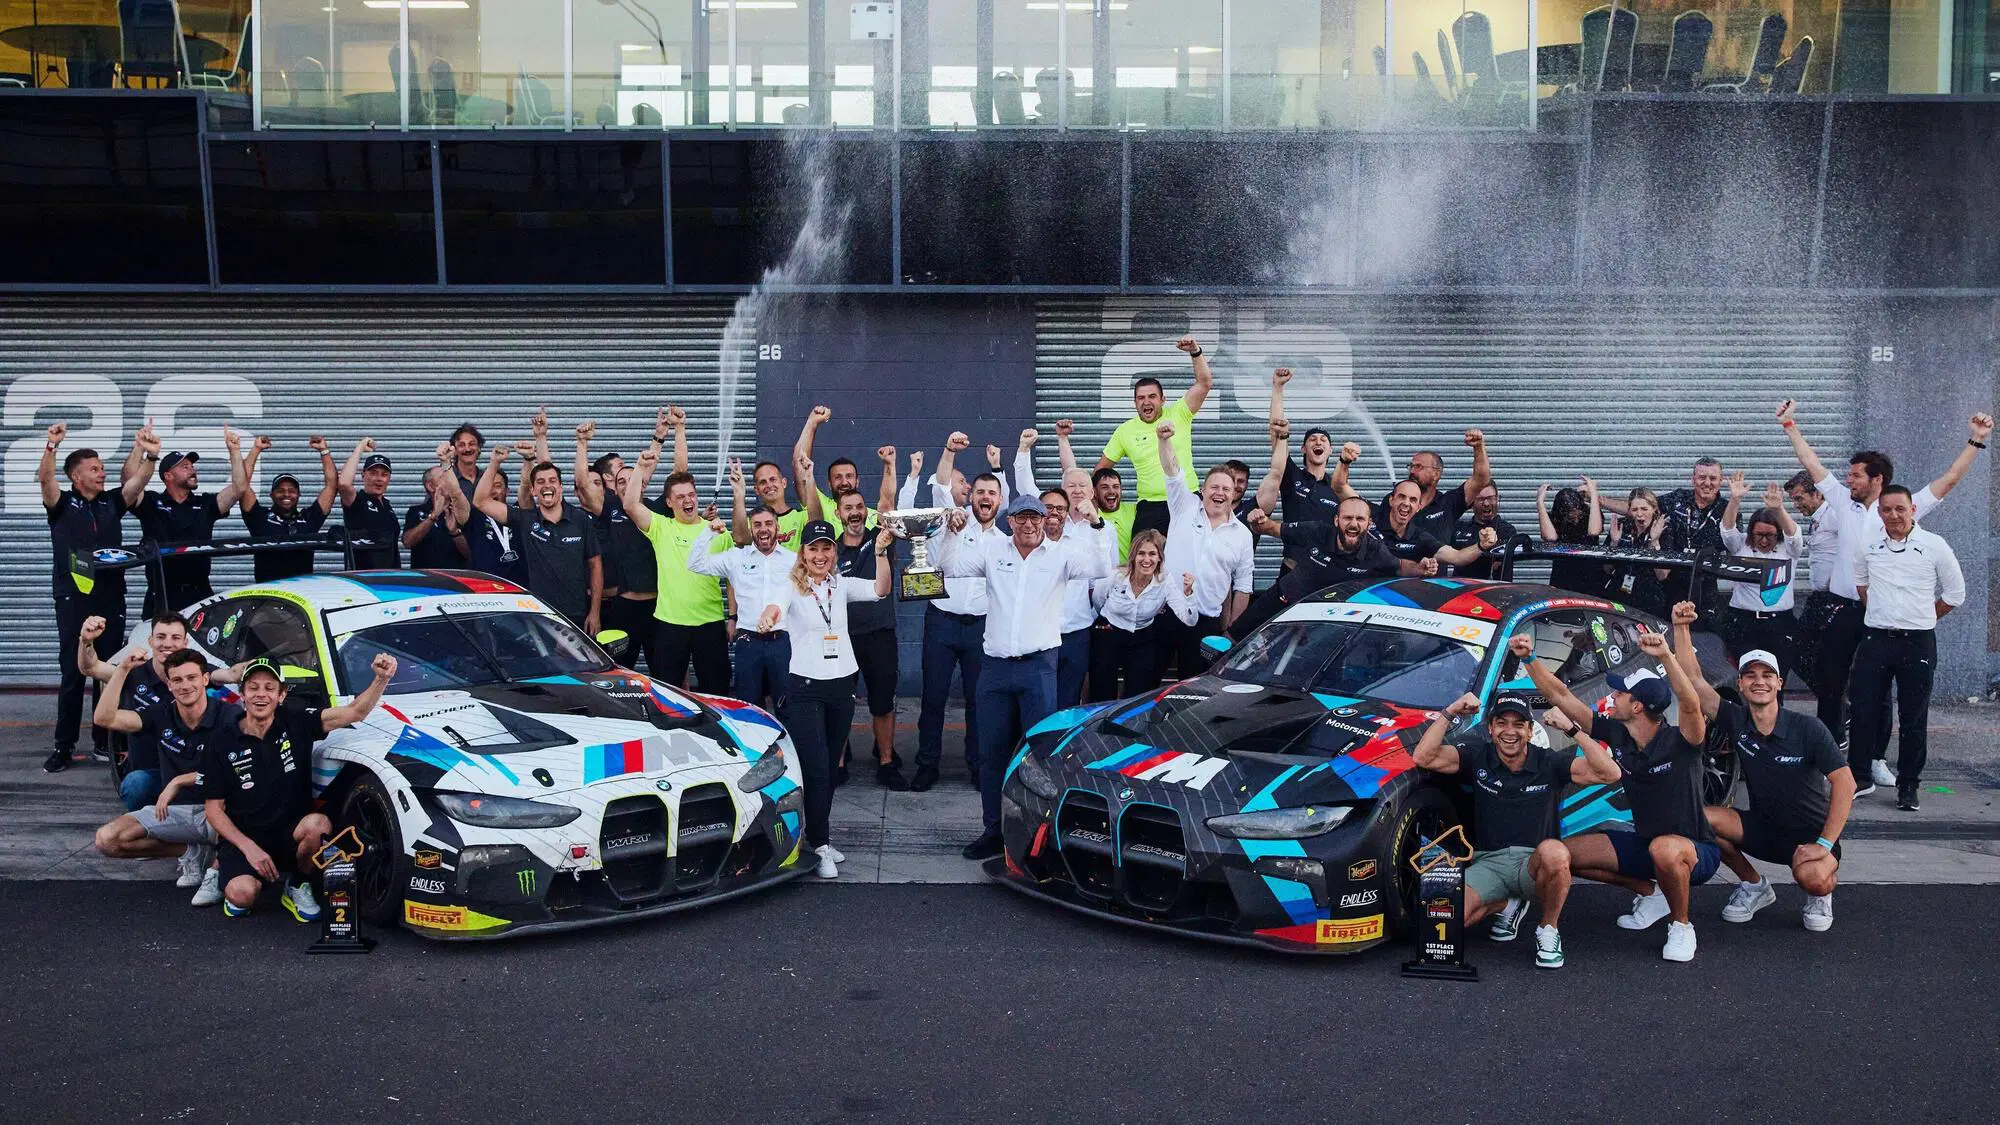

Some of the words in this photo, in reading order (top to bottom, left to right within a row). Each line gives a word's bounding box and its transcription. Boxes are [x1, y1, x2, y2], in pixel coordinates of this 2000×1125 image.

[759, 344, 782, 360] 26
[1871, 346, 1894, 362] 25
[438, 599, 504, 610] Motorsport
[515, 599, 540, 611] 46
[1373, 611, 1443, 629] Motorsport
[1451, 625, 1482, 640] 32
[607, 691, 653, 700] Motorsport
[413, 703, 476, 720] SKECHERS
[1325, 718, 1380, 739] Motorsport
[642, 731, 715, 774] M
[1133, 753, 1231, 791] M
[606, 833, 651, 850] WRT
[410, 876, 446, 892] ENDLESS
[1340, 889, 1378, 906] ENDLESS
[335, 908, 346, 923] 2
[408, 905, 462, 925] PIRELLI
[1322, 919, 1379, 938] PIRELLI
[1435, 922, 1447, 941] 1
